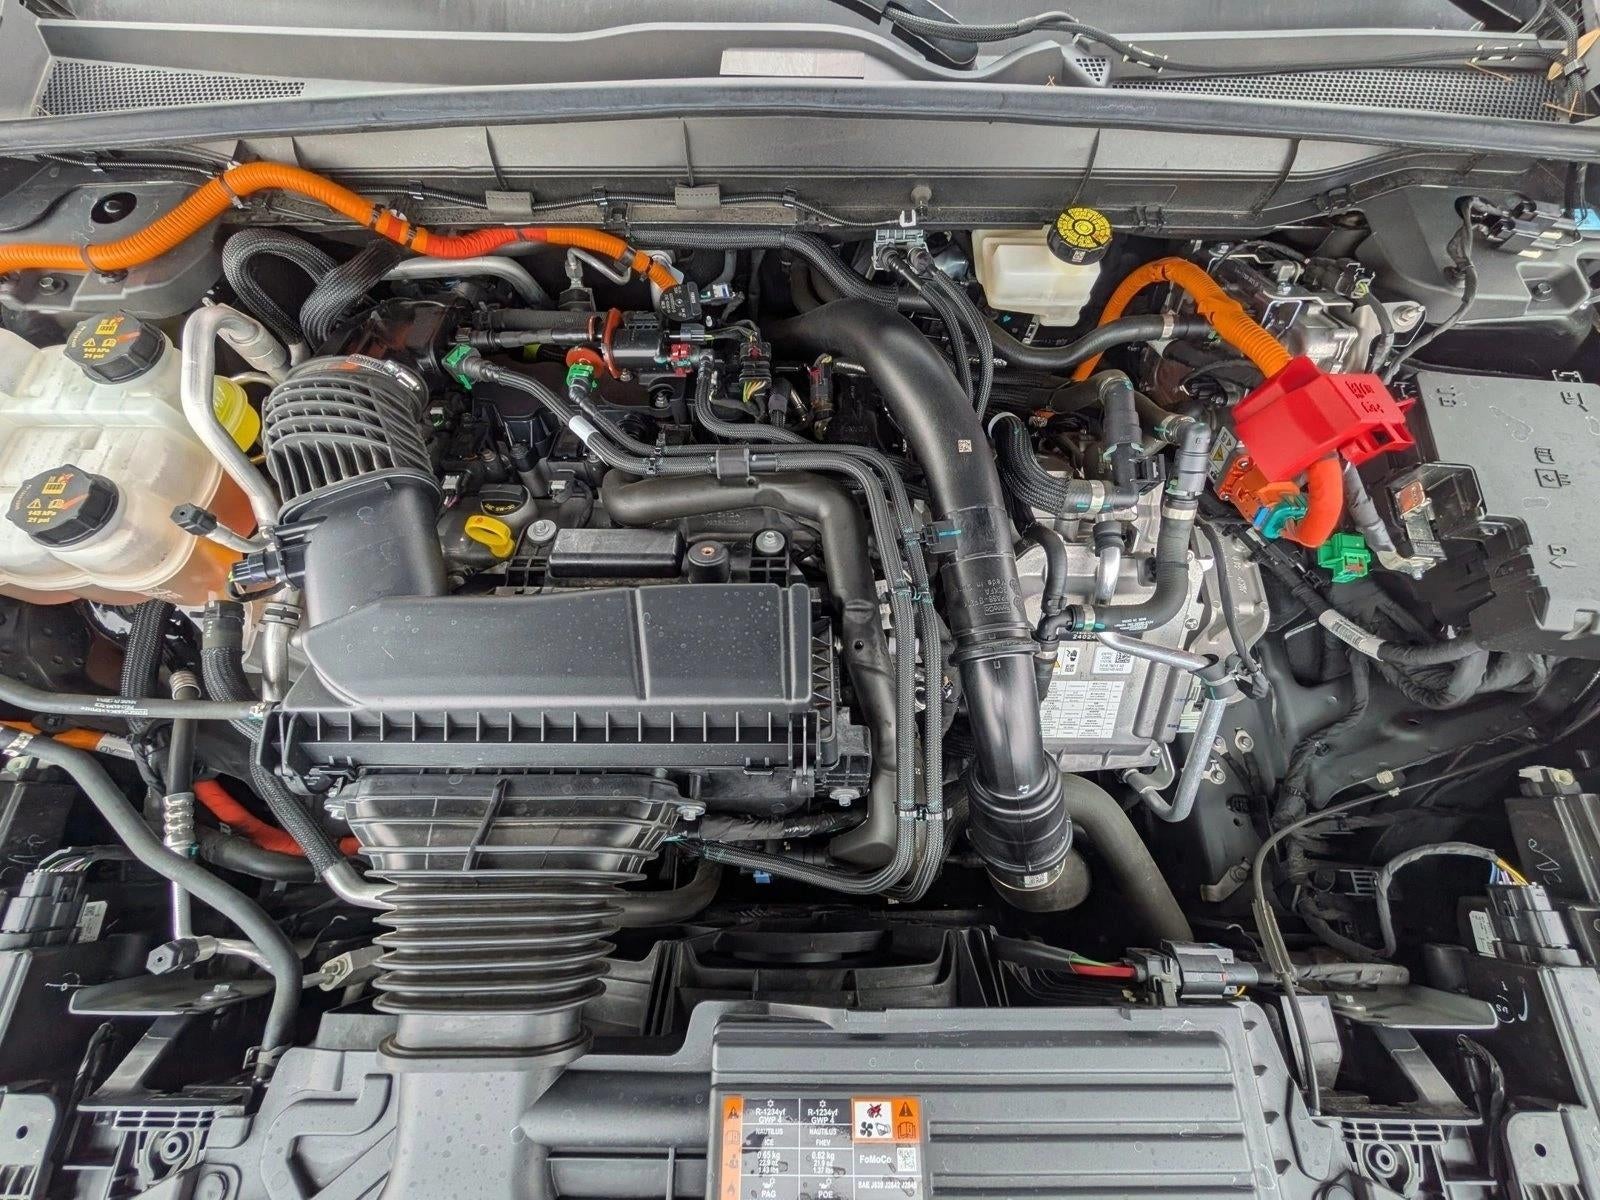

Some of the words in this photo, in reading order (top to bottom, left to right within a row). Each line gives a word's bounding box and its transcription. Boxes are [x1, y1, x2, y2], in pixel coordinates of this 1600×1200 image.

[755, 1107, 786, 1118] R-1234yf
[807, 1108, 838, 1118] R-1234yf
[758, 1115, 776, 1124] GWP
[811, 1116, 829, 1124] GWP
[755, 1127, 784, 1135] NAUTILUS
[809, 1127, 837, 1136] NAUTILUS
[764, 1138, 775, 1146] ICE
[815, 1138, 831, 1146] FHEV
[772, 1151, 781, 1161] kg
[826, 1151, 835, 1161] kg
[859, 1155, 892, 1164] FoMoCo
[858, 1181, 870, 1189] SAE
[761, 1190, 777, 1198] PAG
[817, 1190, 834, 1199] POE
